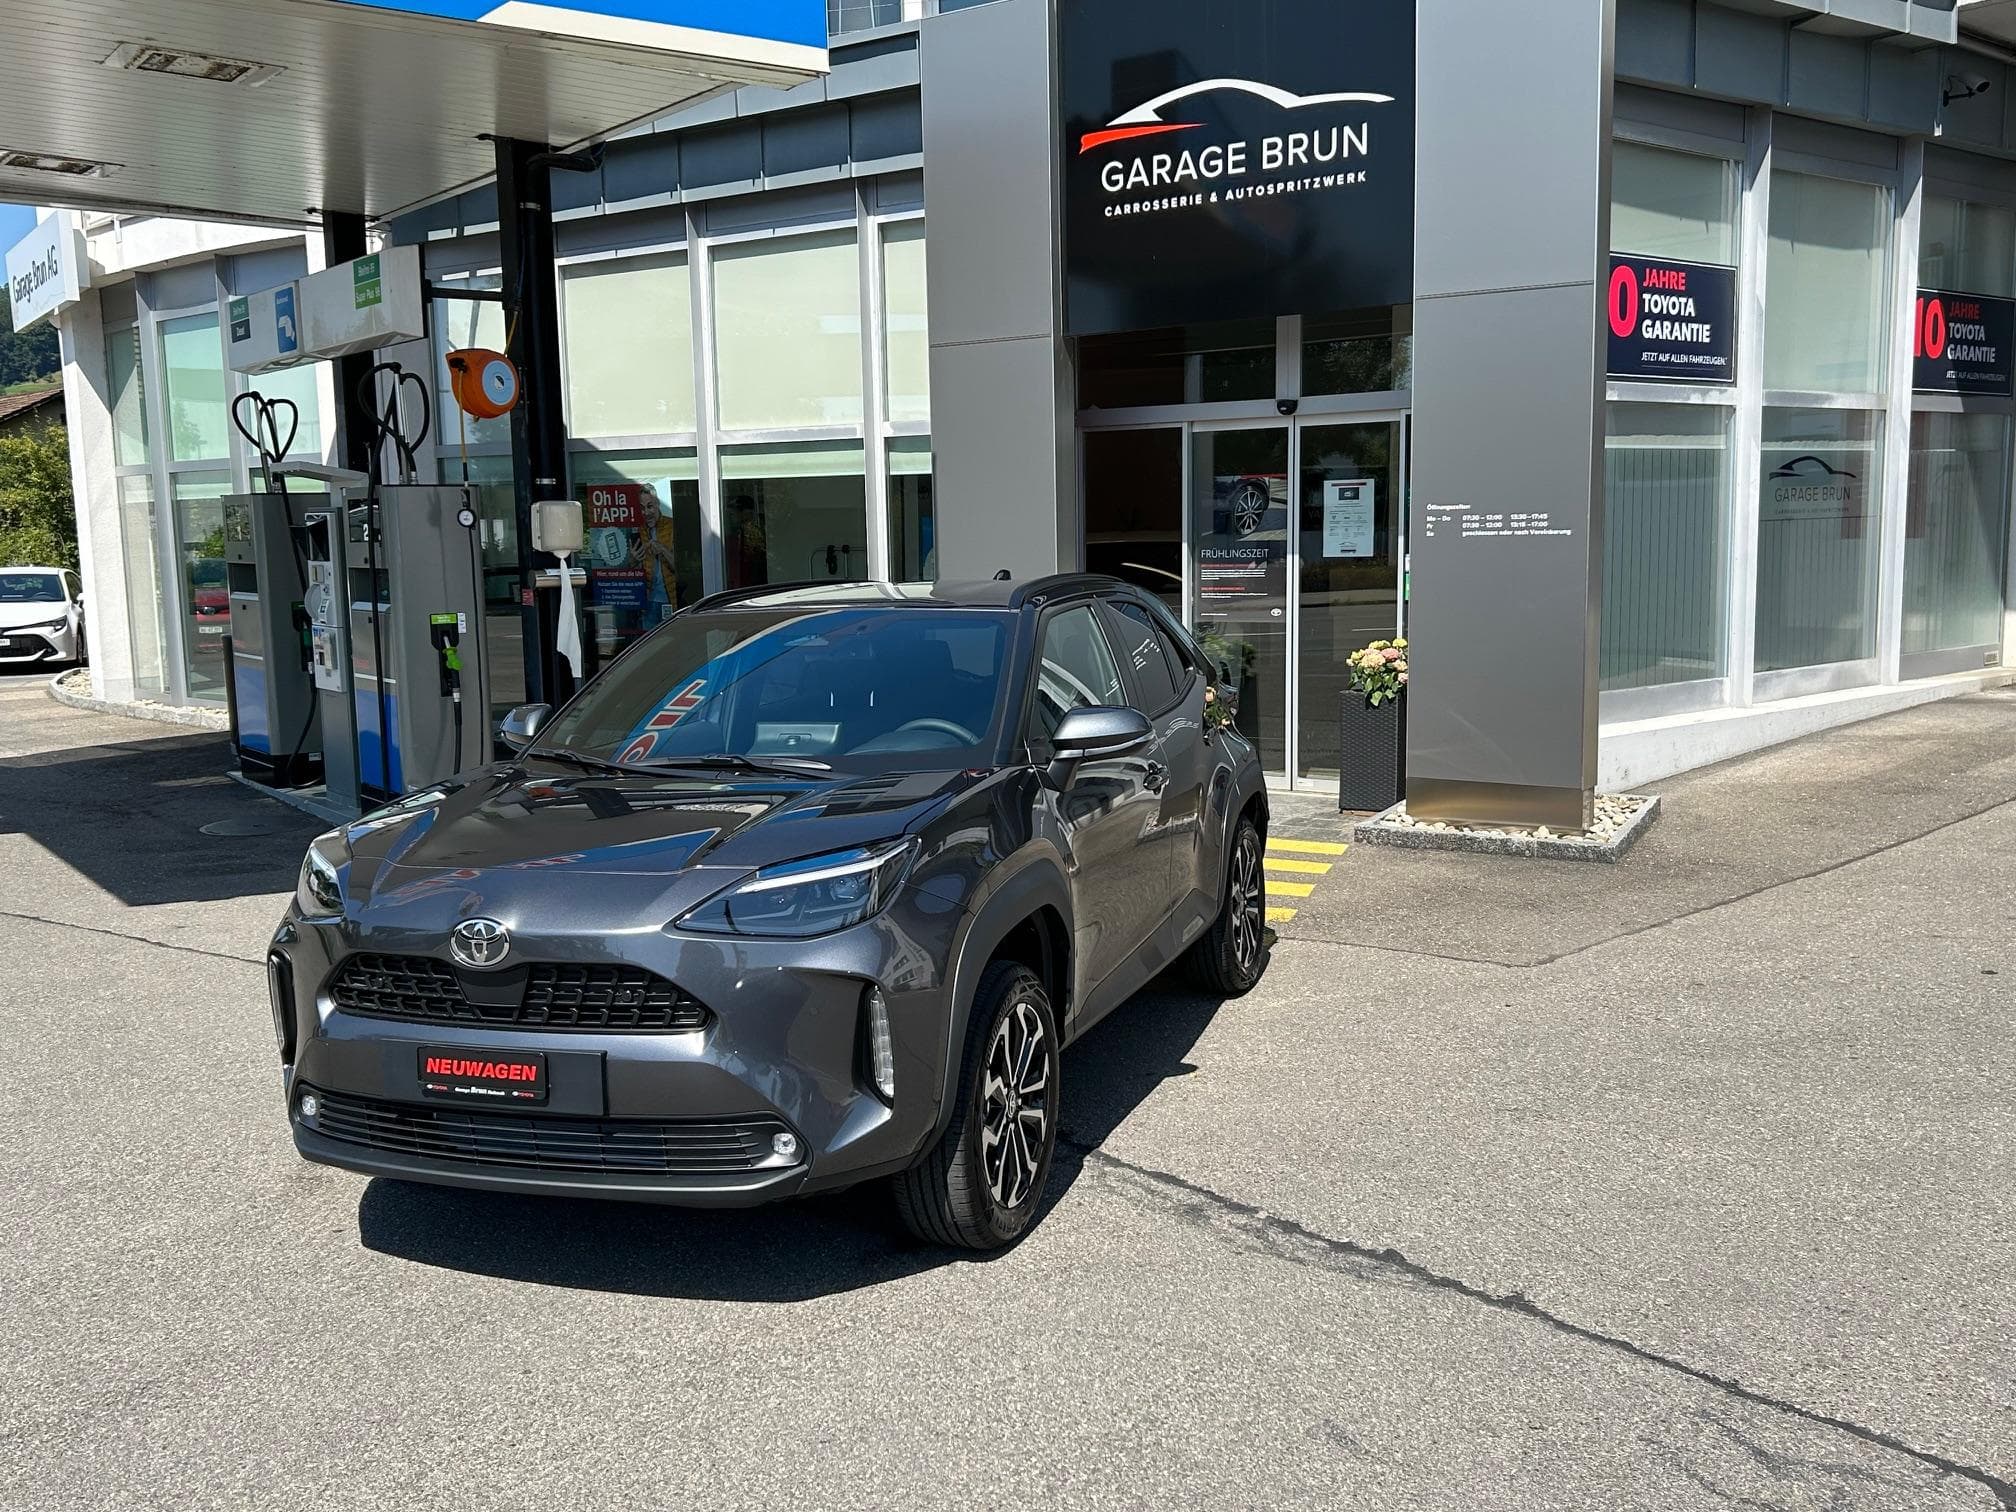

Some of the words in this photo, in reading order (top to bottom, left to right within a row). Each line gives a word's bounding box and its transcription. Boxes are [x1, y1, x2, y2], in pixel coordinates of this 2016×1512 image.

[1101, 141, 1247, 192] GARAGE
[1262, 122, 1368, 170] BRUN
[1104, 193, 1203, 218] CARROSSERIE
[1209, 191, 1218, 203] &
[1225, 170, 1367, 201] AUTOSPRITZWERK
[12, 275, 34, 304] Garage
[32, 260, 48, 290] Brun
[47, 244, 58, 280] AG
[1642, 268, 1687, 291] JAHRE
[1642, 293, 1696, 317] TOYOTA
[1949, 301, 1981, 320] JAHRE
[1641, 319, 1712, 343] GARANTIE
[1948, 322, 1986, 341] TOYOTA
[1641, 351, 1659, 362] JETZT
[1658, 352, 1671, 363] AUF
[1671, 353, 1689, 364] ALLEN
[1947, 343, 1997, 363] GARANTIE
[592, 490, 612, 506] Oh
[615, 490, 627, 505] la
[1774, 487, 1819, 502] GARAGE
[1822, 485, 1851, 501] BRUN
[1200, 547, 1269, 559] FRÜHLINGSZEIT
[426, 1057, 537, 1082] NEUWAGEN
